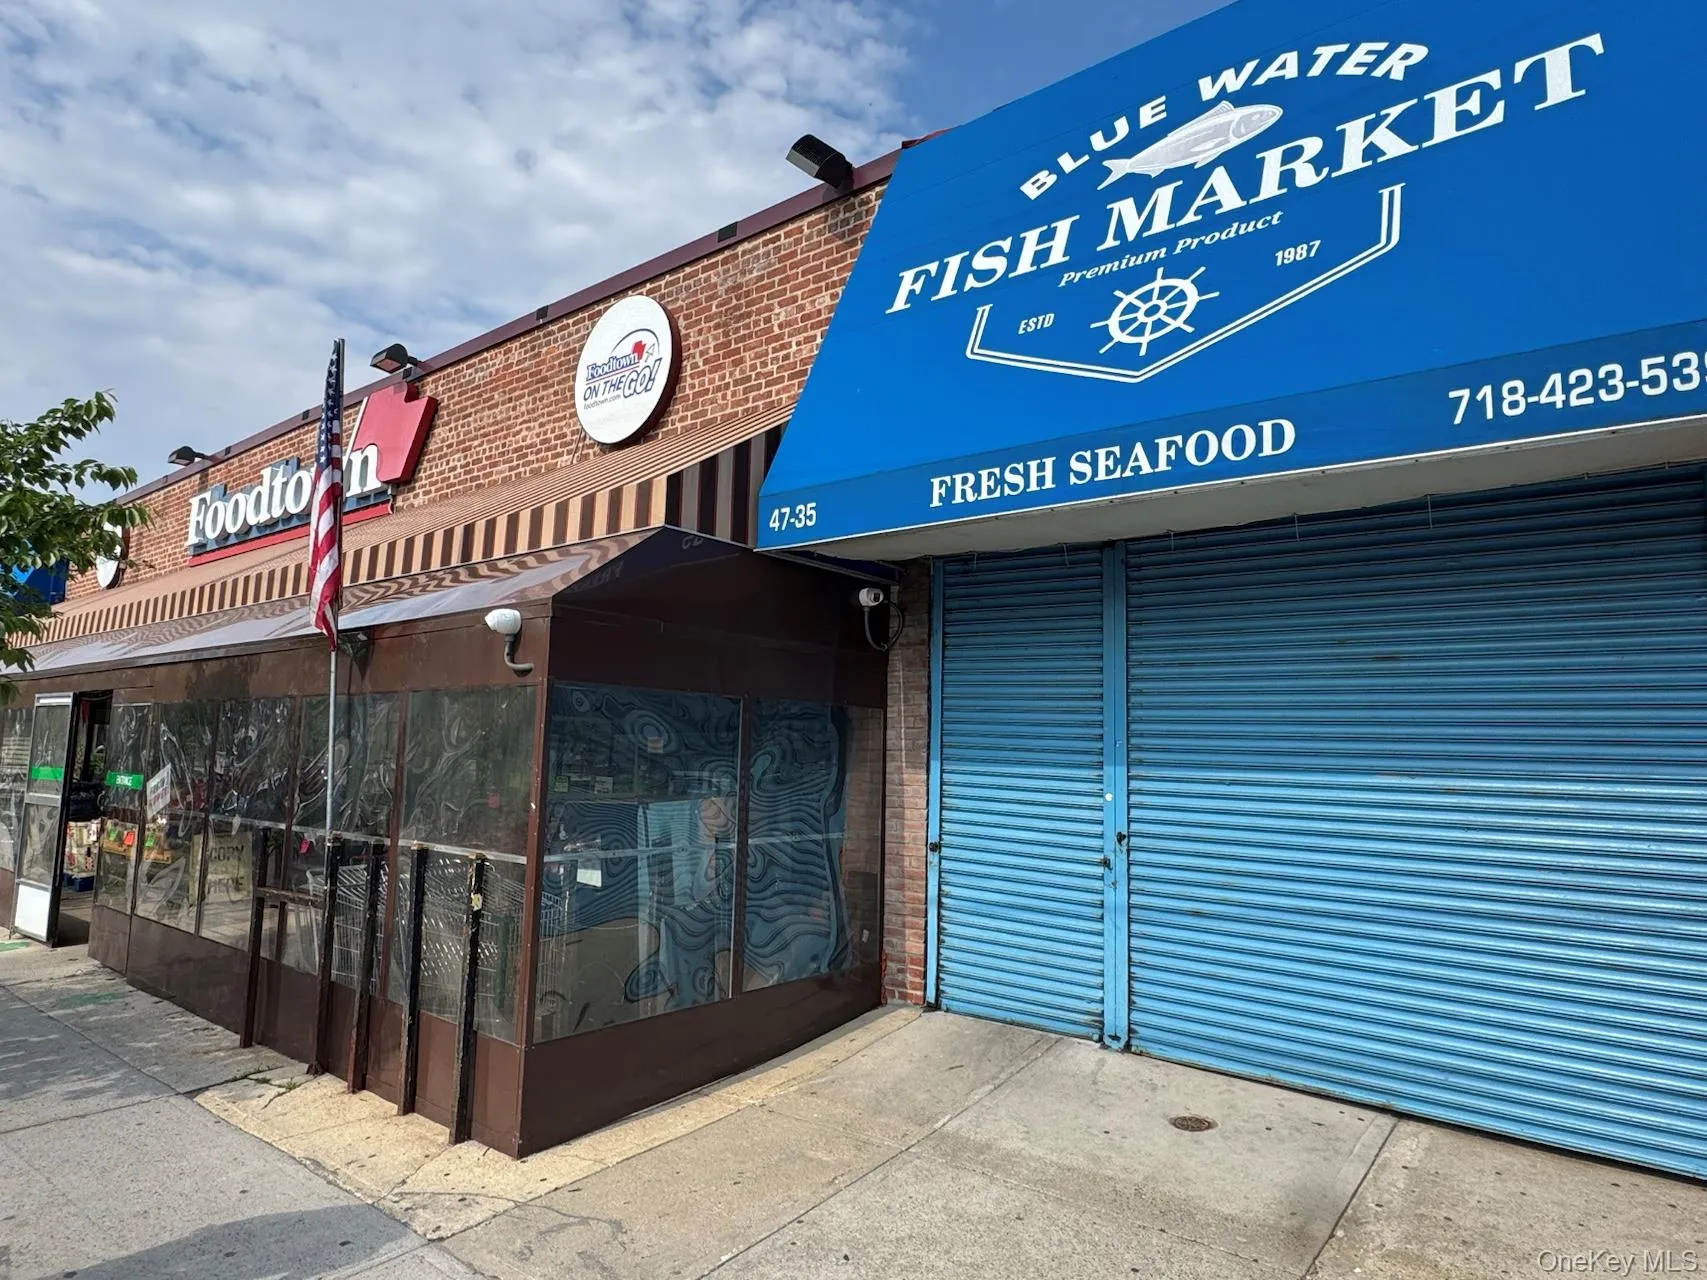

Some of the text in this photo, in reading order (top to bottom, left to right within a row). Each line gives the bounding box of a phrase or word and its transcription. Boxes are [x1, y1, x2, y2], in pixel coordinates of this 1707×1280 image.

[1019, 41, 1430, 201] BLUE WATER
[885, 32, 1605, 315] FISH MARKET
[1056, 209, 1285, 289] Premium Product
[1275, 239, 1322, 267] 1987
[1017, 312, 1056, 335] ESTD
[583, 356, 663, 402] ON THE GO!
[586, 353, 641, 382] Foodtown
[1448, 350, 1707, 426] 718-423-53
[186, 442, 385, 549] Foodton
[929, 417, 1297, 508] FRESH SEAFOOD
[768, 501, 818, 533] 47-35
